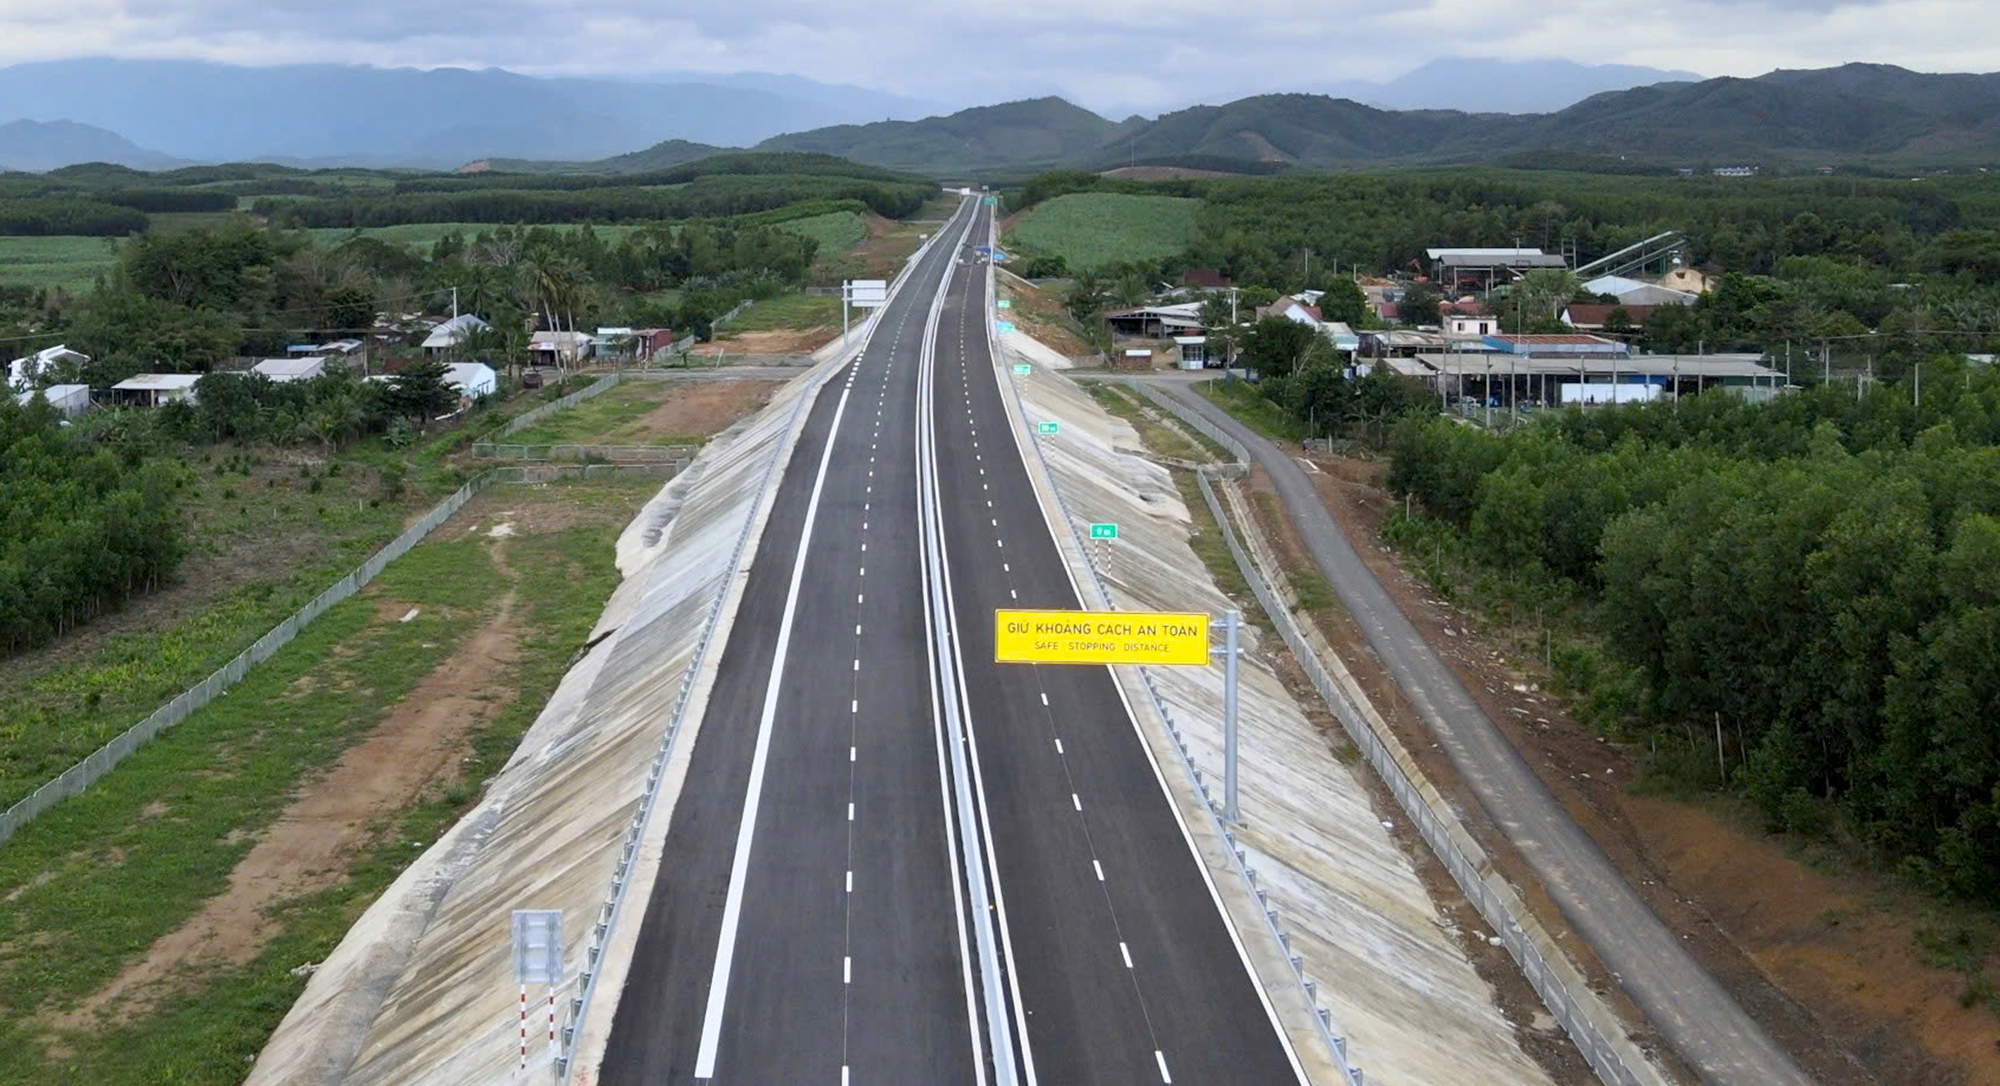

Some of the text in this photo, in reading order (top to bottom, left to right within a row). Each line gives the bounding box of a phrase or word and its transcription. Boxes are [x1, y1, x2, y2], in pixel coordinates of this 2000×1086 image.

[1137, 624, 1157, 636] AN
[1034, 641, 1170, 653] SAFE STOPPING DISTANCE
